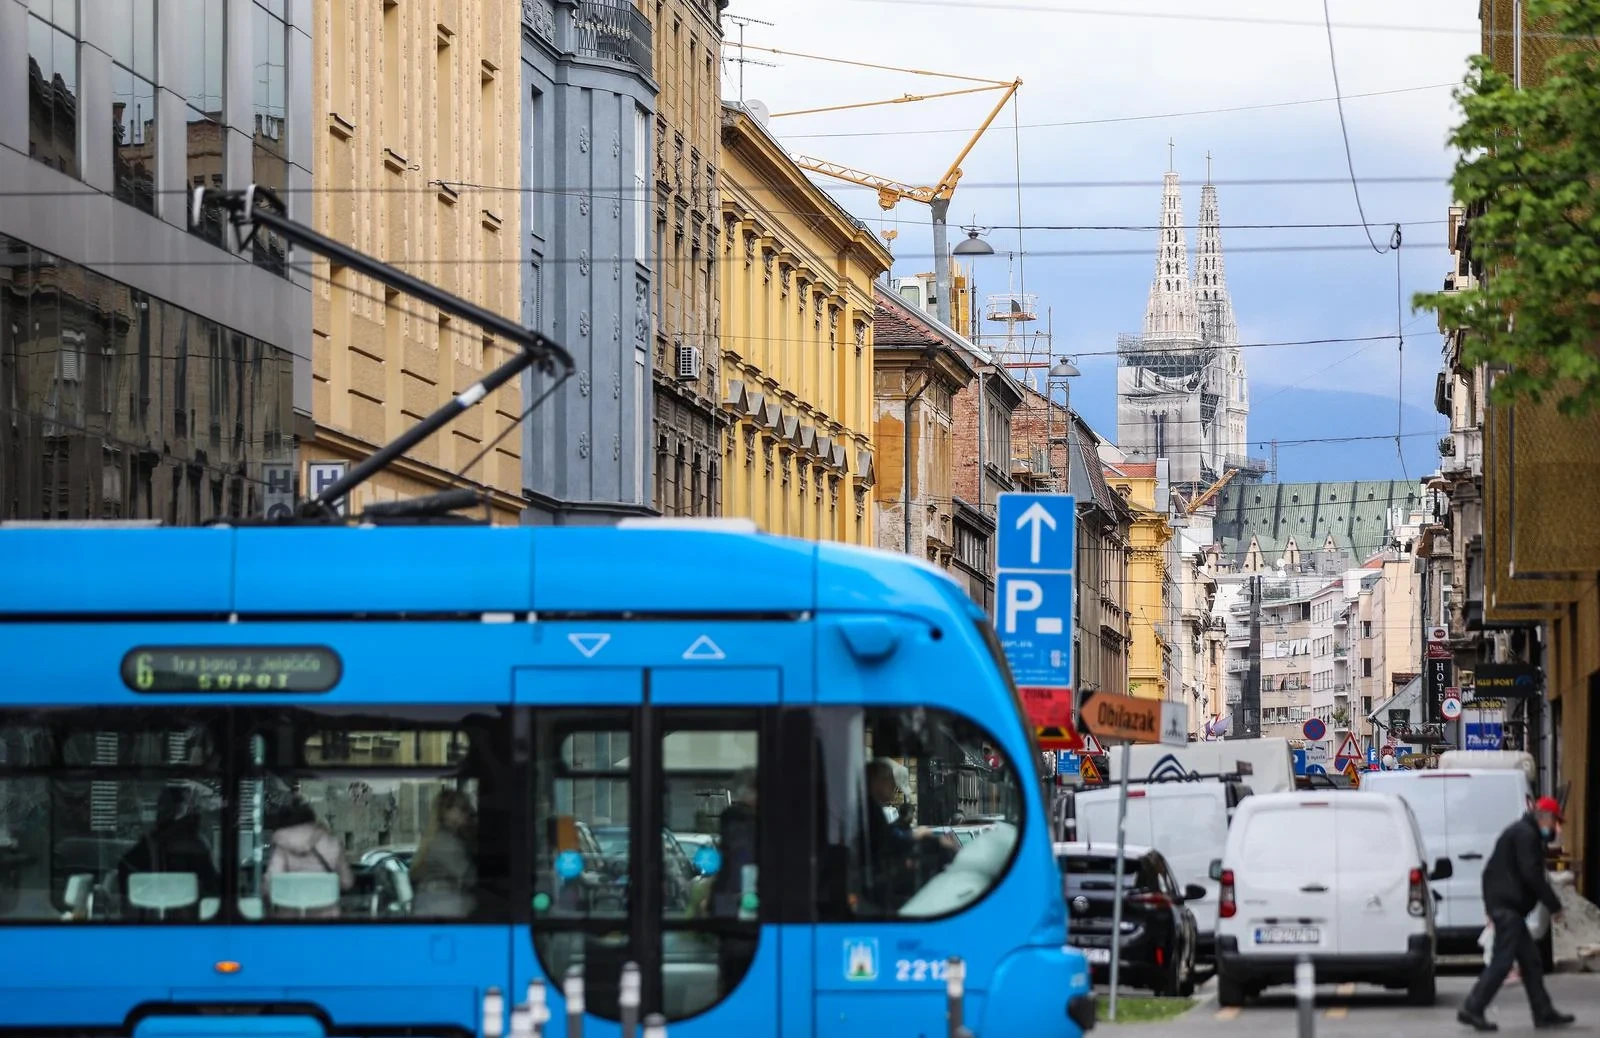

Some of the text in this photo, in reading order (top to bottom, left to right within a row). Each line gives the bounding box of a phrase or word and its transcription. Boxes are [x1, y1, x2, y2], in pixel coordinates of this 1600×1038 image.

[1005, 580, 1043, 633] P
[136, 654, 154, 689] 6
[199, 673, 289, 689] SOPOT
[1436, 662, 1444, 707] HOTE
[1097, 700, 1156, 732] Obilazak
